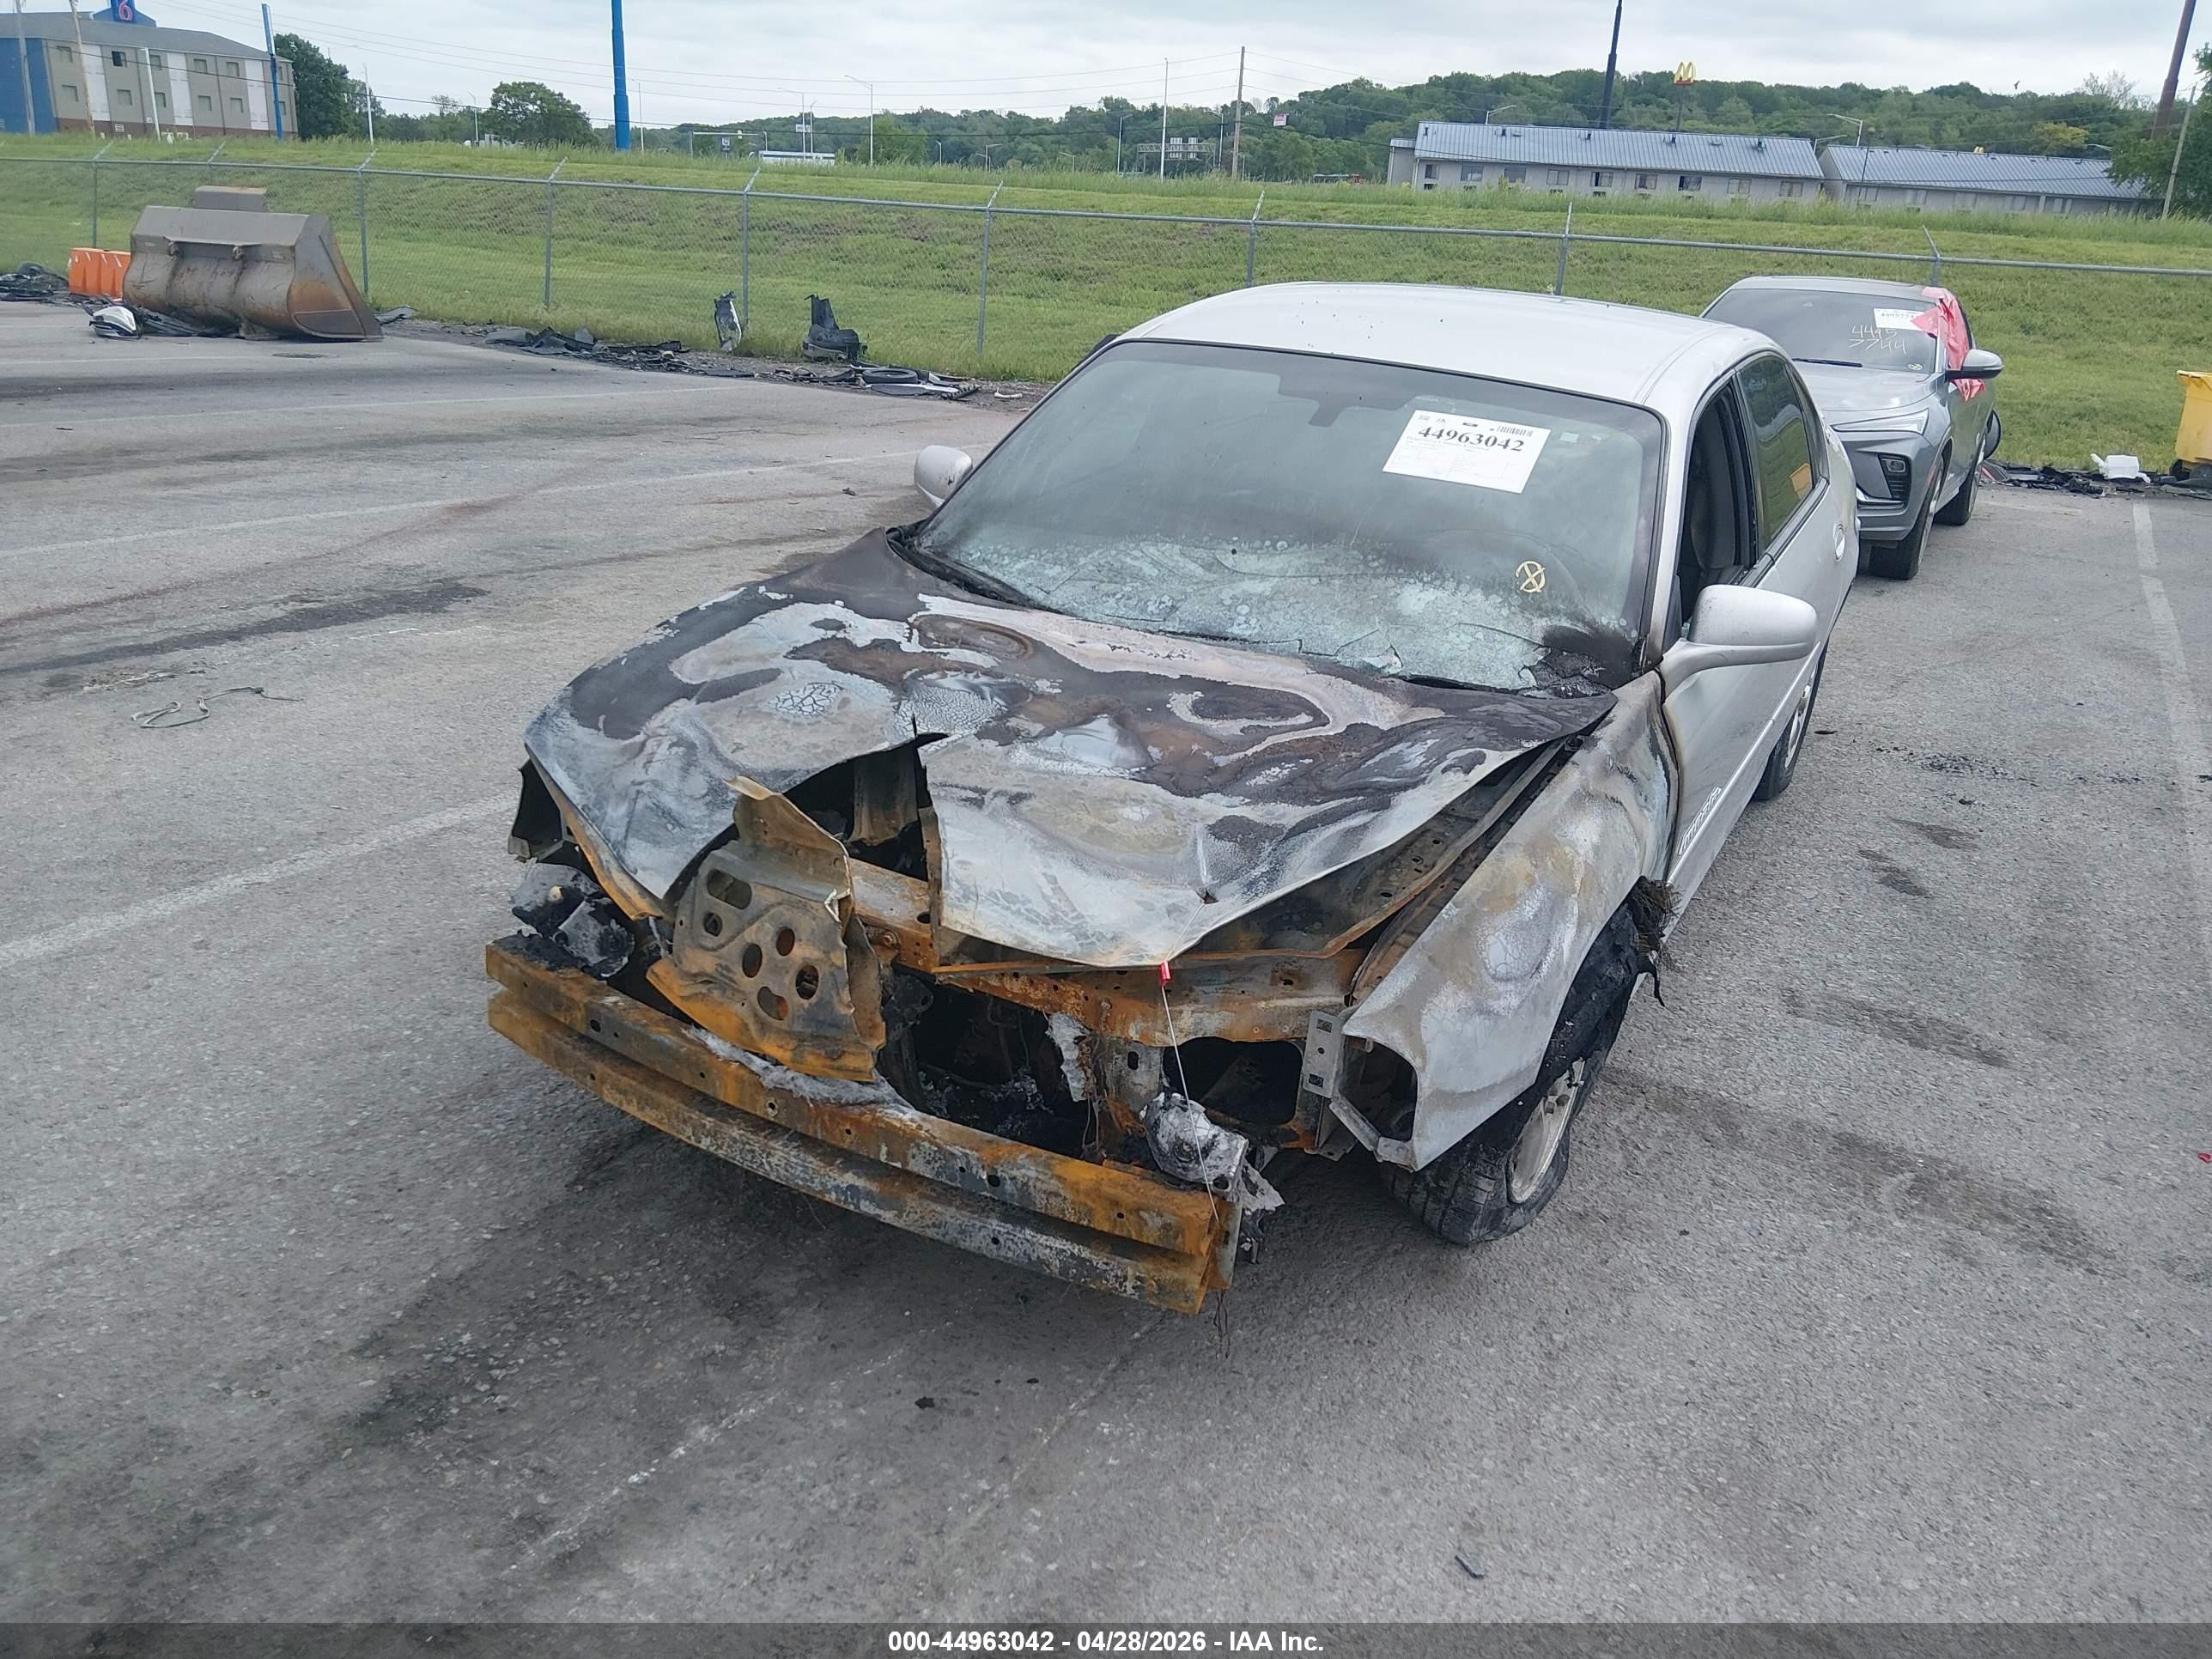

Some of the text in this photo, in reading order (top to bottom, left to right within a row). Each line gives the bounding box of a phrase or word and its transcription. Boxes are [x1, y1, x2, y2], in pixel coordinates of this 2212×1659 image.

[118, 0, 133, 21] 6
[1851, 324, 1898, 340] 4495
[1849, 338, 1907, 355] 7744
[1418, 426, 1524, 452] 44963042
